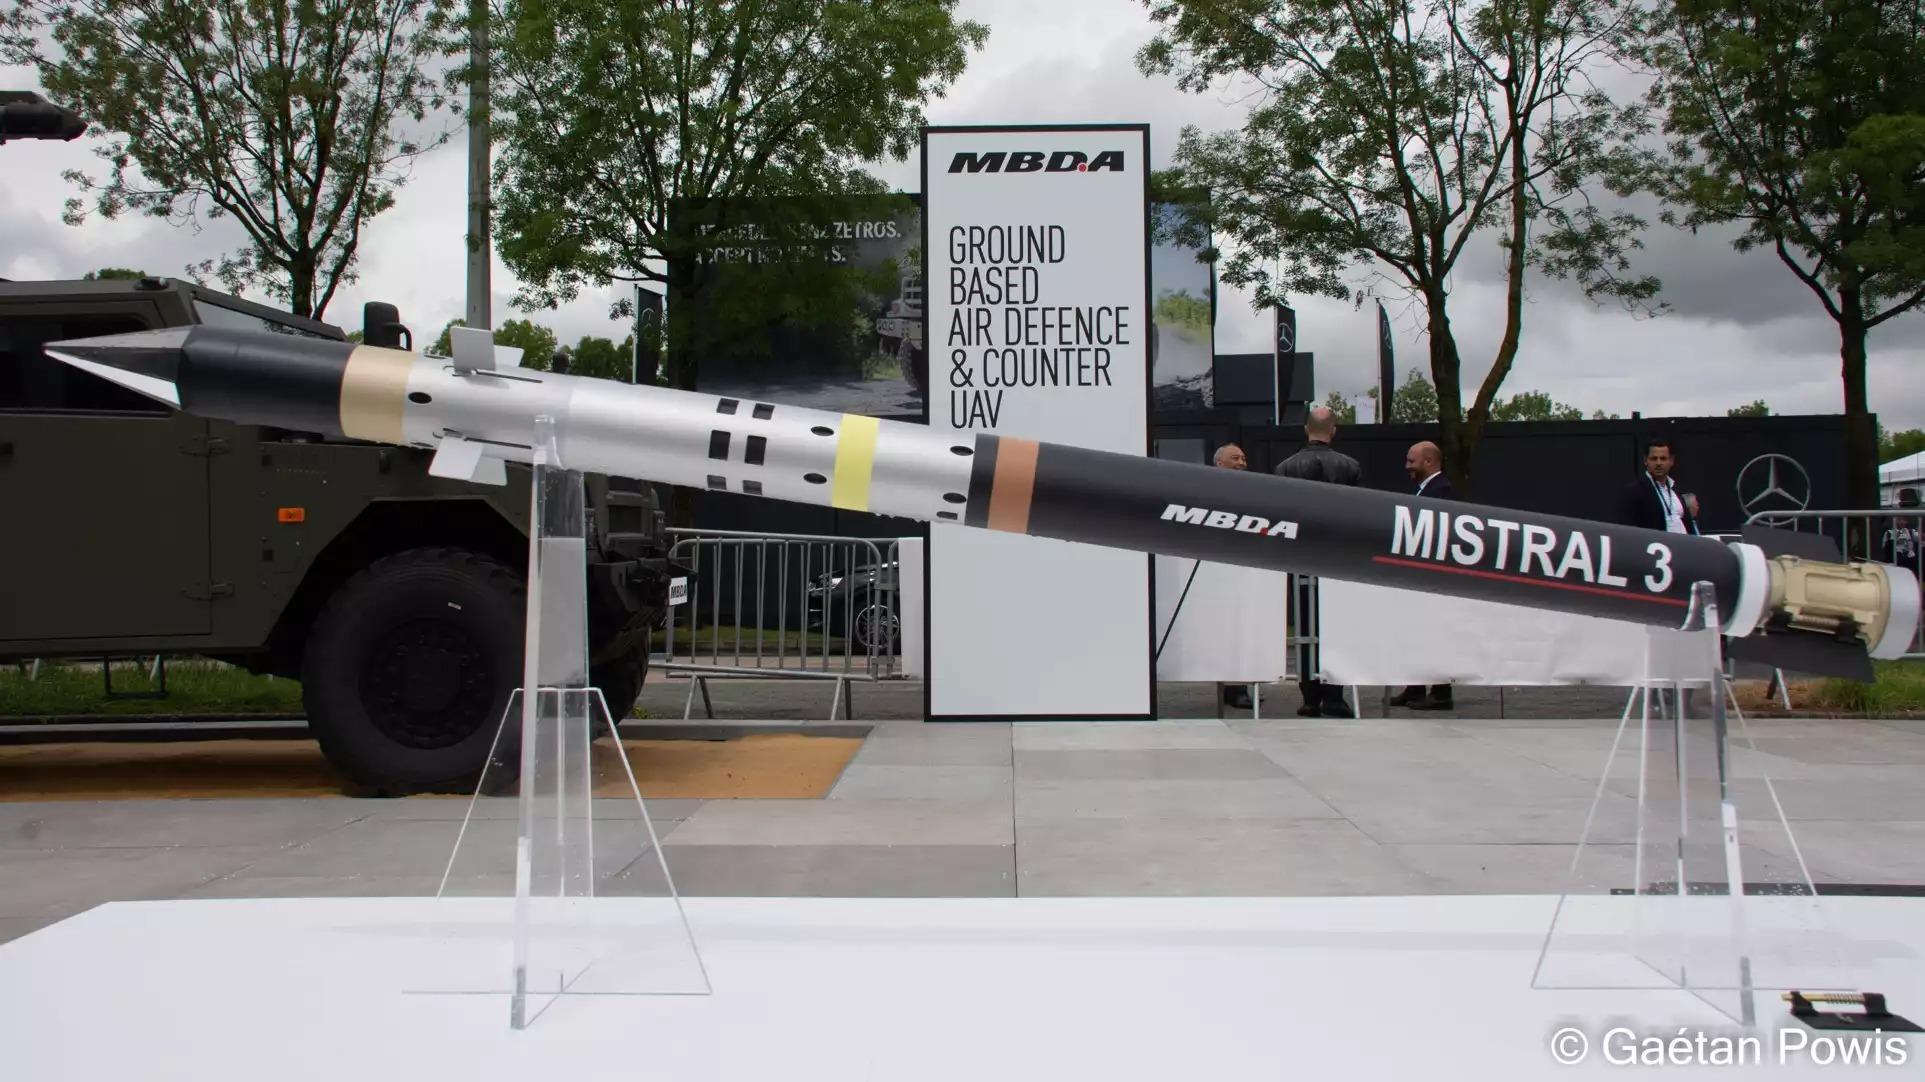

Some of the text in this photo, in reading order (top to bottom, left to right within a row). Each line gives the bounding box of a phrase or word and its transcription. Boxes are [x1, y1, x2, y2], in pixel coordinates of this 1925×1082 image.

[950, 225, 1065, 264] GROUND
[950, 267, 1039, 305] BASED
[948, 306, 1130, 346] AIR DEFENCE
[950, 348, 1112, 387] & COUNTER
[950, 390, 1003, 428] UAV
[1391, 505, 1673, 592] MISTRAL 3
